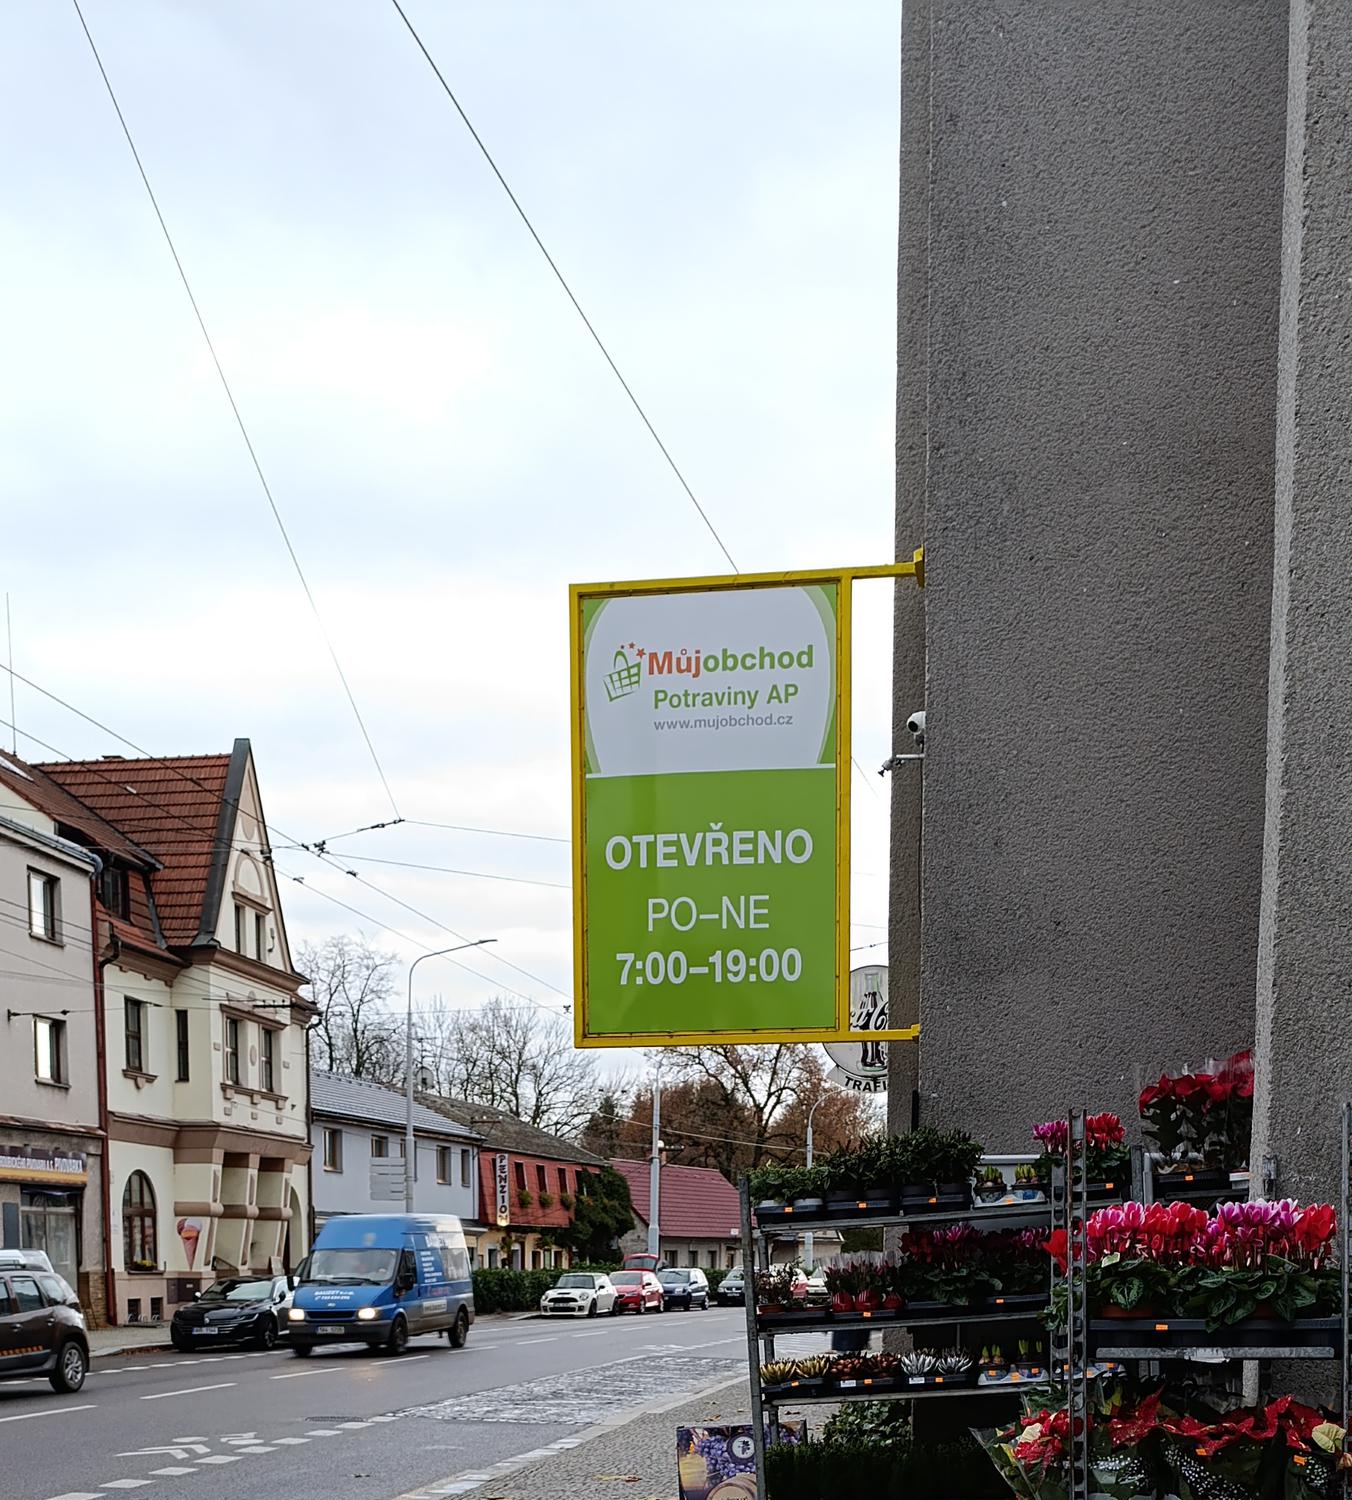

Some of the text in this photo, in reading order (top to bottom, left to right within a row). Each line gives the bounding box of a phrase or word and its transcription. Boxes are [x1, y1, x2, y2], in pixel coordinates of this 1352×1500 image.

[648, 644, 814, 678] Můjobchod
[654, 684, 799, 710] Potraviny AP
[653, 712, 794, 730] www.mujobchod.cz
[605, 822, 814, 870] OTEVŘENO
[845, 1076, 887, 1092] TRAFI
[498, 1154, 508, 1223] PENZION
